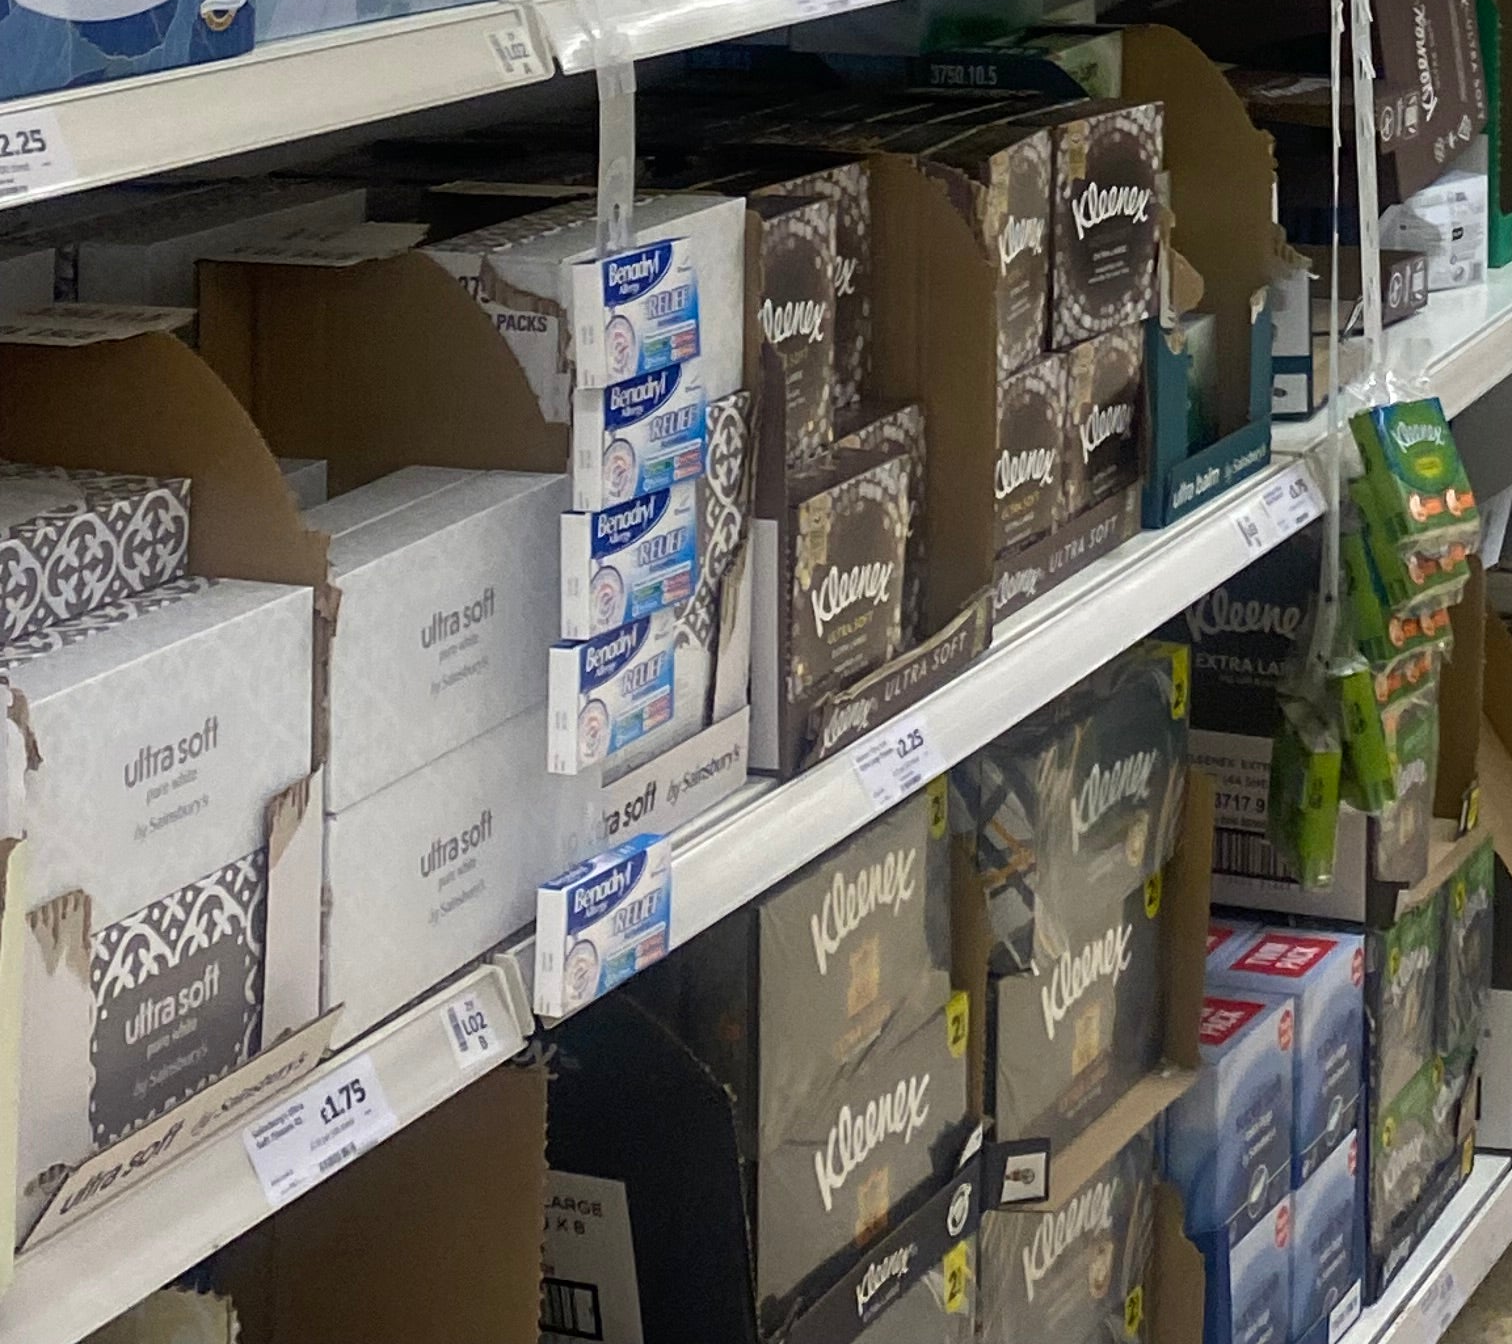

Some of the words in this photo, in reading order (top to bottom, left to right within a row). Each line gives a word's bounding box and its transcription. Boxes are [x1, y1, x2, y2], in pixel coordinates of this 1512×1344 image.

[1073, 181, 1152, 240] Kleenex
[608, 249, 662, 286] Benadryl
[496, 312, 548, 333] PACKS
[647, 284, 690, 318] RELIEF
[610, 370, 669, 410] Benadryl
[650, 404, 696, 443] RELIEF
[596, 498, 656, 539] Benadryl
[637, 527, 686, 566] RELIEF
[1049, 539, 1087, 574] ULTRA
[1088, 514, 1118, 550] SOFT
[420, 610, 454, 651] ultra
[457, 584, 496, 629] soft
[812, 561, 894, 638] Kleenex
[585, 627, 639, 675] Benadryl
[622, 650, 666, 696] RELIEF
[884, 662, 928, 703] ULTRA
[931, 631, 967, 673] SOFT
[124, 743, 174, 790] ultra
[179, 715, 220, 764] soft
[622, 781, 658, 828] soft
[680, 744, 742, 795] Sainsbury's
[1072, 748, 1156, 853] Kleenex
[420, 836, 452, 880] ultra
[455, 806, 493, 854] soft
[573, 862, 634, 914] Benadryl
[613, 887, 662, 935] RELIEF
[812, 847, 917, 976] Kleenex
[125, 997, 175, 1047] ultra
[177, 960, 221, 1011] soft
[1042, 921, 1133, 1041] Kleenex
[320, 1078, 366, 1125] £1.75
[59, 1163, 122, 1216] ultra
[124, 1118, 187, 1168] soft
[816, 1073, 930, 1212] Kleenex
[1022, 1178, 1119, 1302] Kleenex
[856, 1249, 912, 1316] Kleenex
